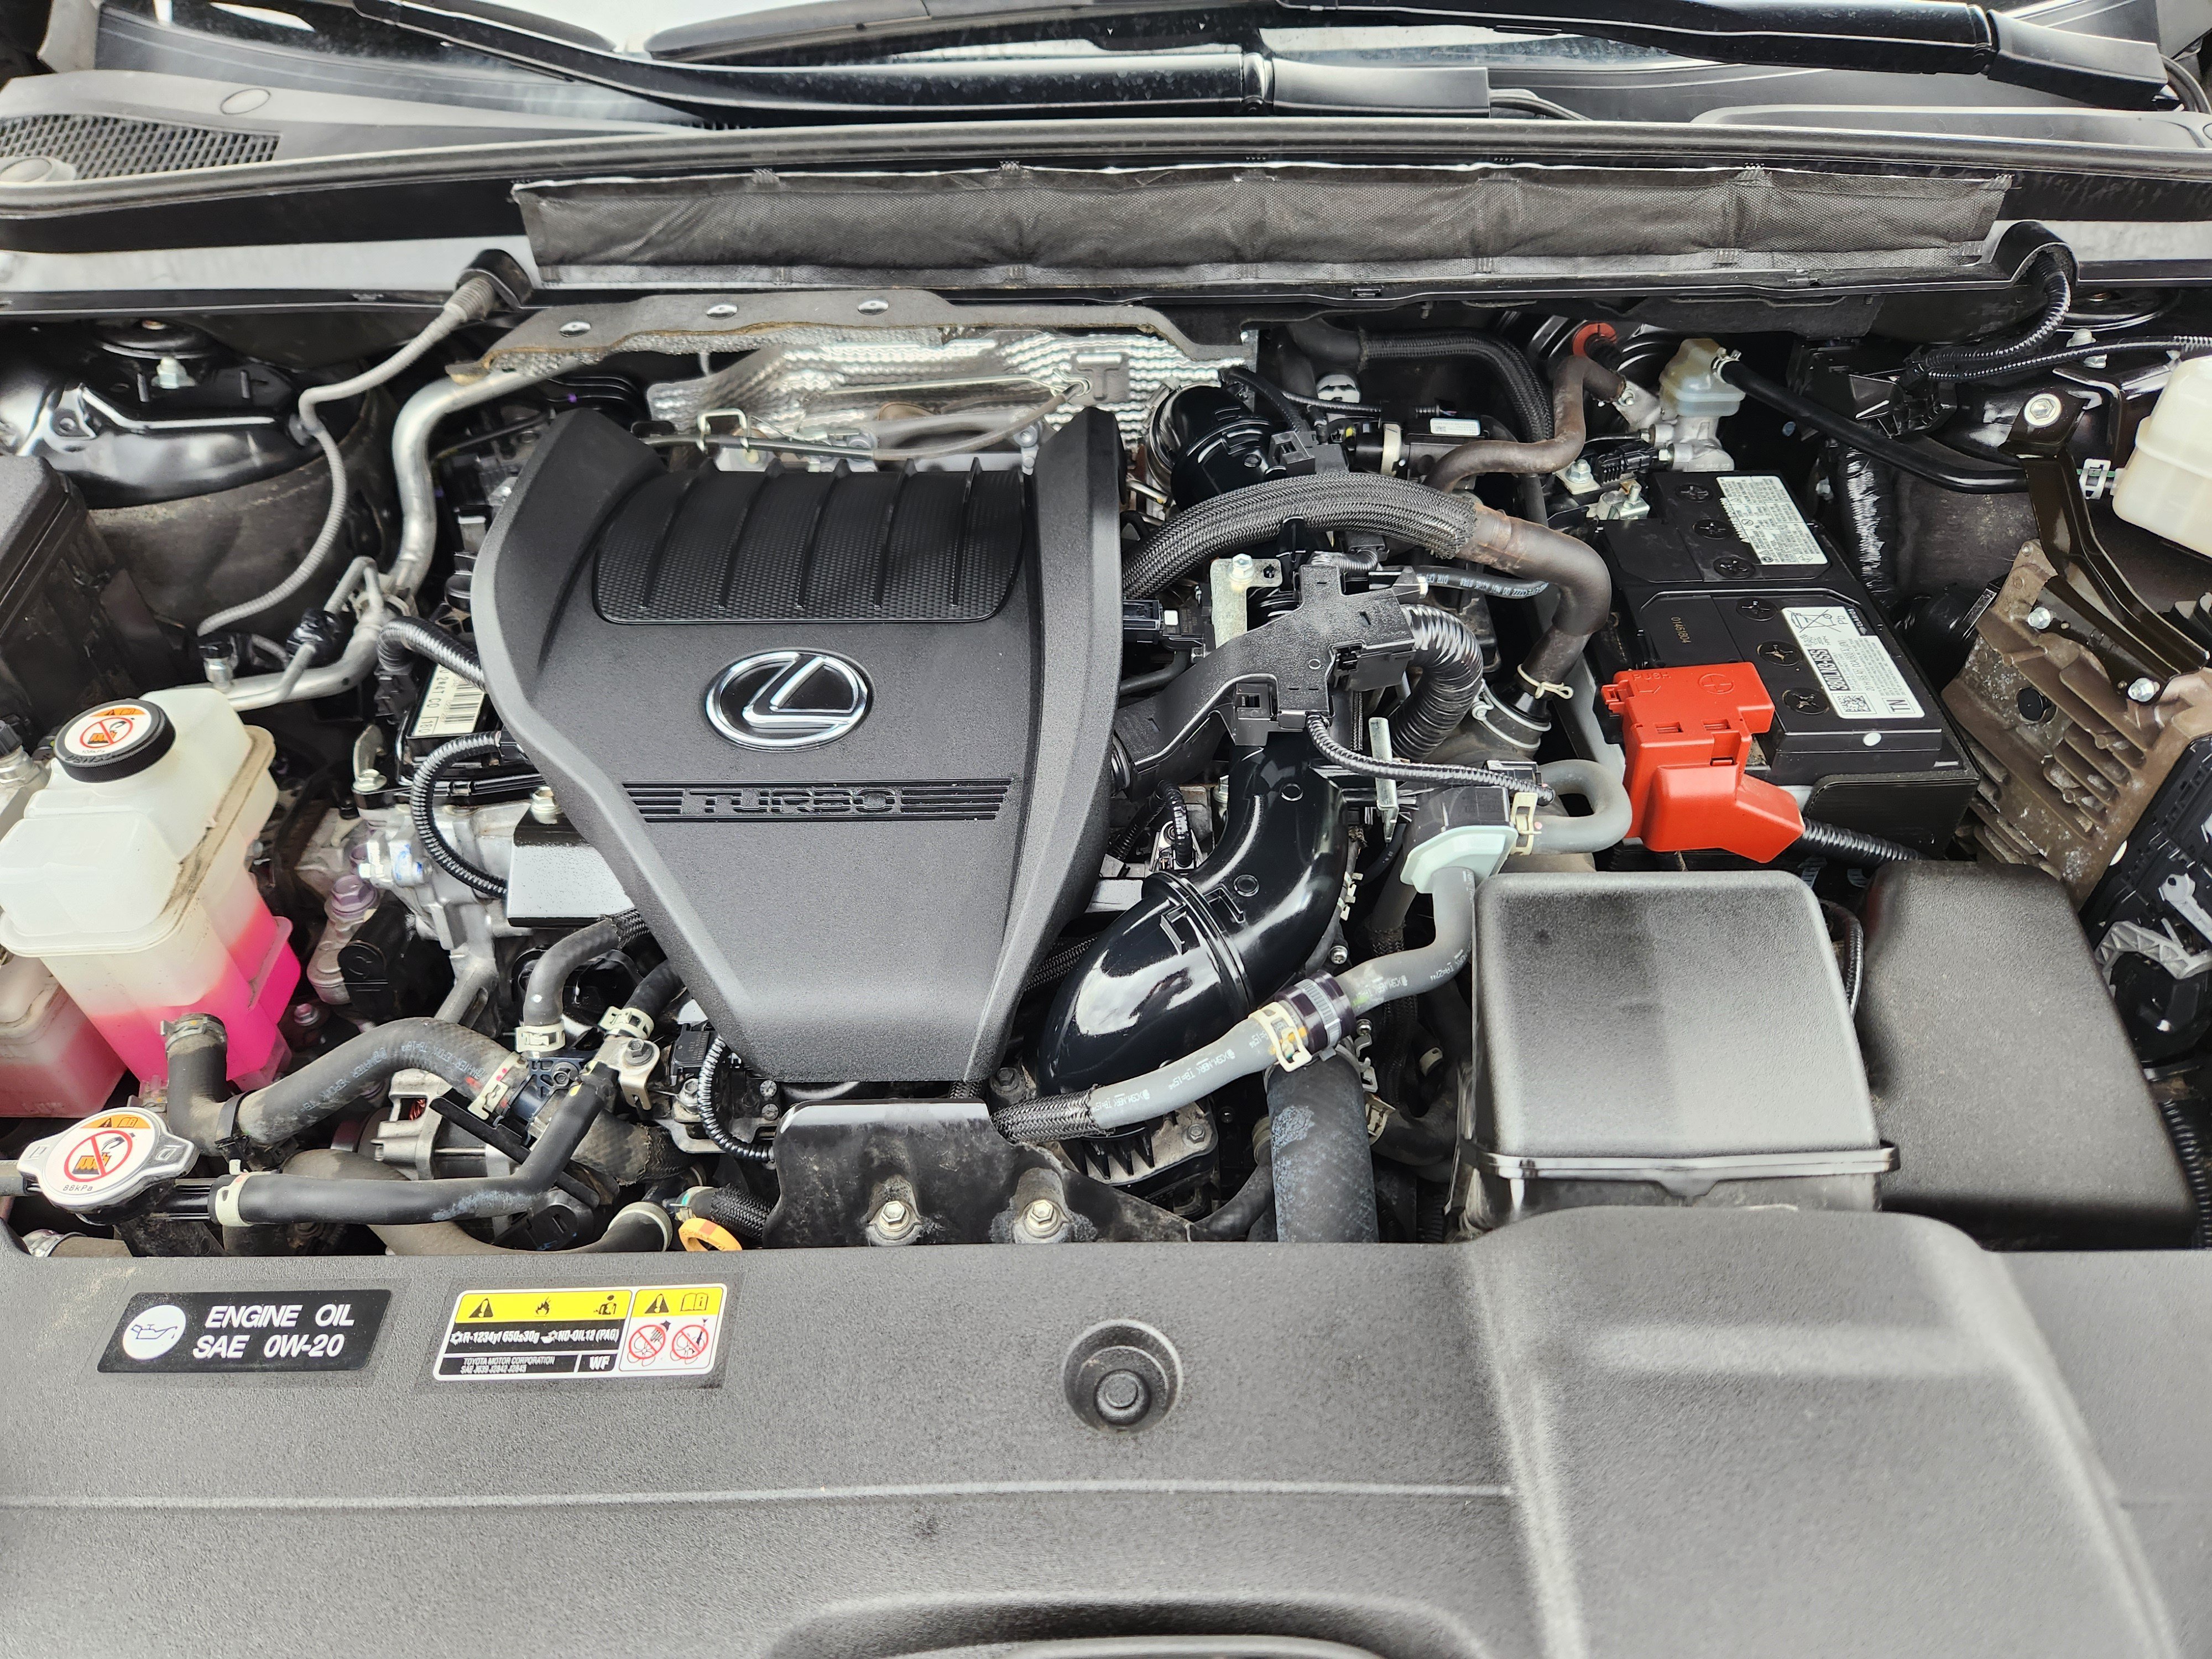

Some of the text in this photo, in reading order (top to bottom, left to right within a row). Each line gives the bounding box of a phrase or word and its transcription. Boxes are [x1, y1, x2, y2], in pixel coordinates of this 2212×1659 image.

[1837, 615, 1849, 625] Pb
[1632, 671, 1672, 681] PUSH
[1886, 699, 1911, 712] TN
[689, 787, 896, 813] TURBO
[204, 1303, 354, 1328] ENGINE OIL
[463, 1331, 503, 1345] R-1234yf
[502, 1330, 540, 1344] 650±30g
[596, 1328, 619, 1343] (PAG)
[192, 1333, 345, 1359] SAE 0W-20
[463, 1356, 556, 1365] TOYOTA MOTOR CORPORATION
[589, 1355, 610, 1370] WF
[460, 1365, 474, 1374] SAE
